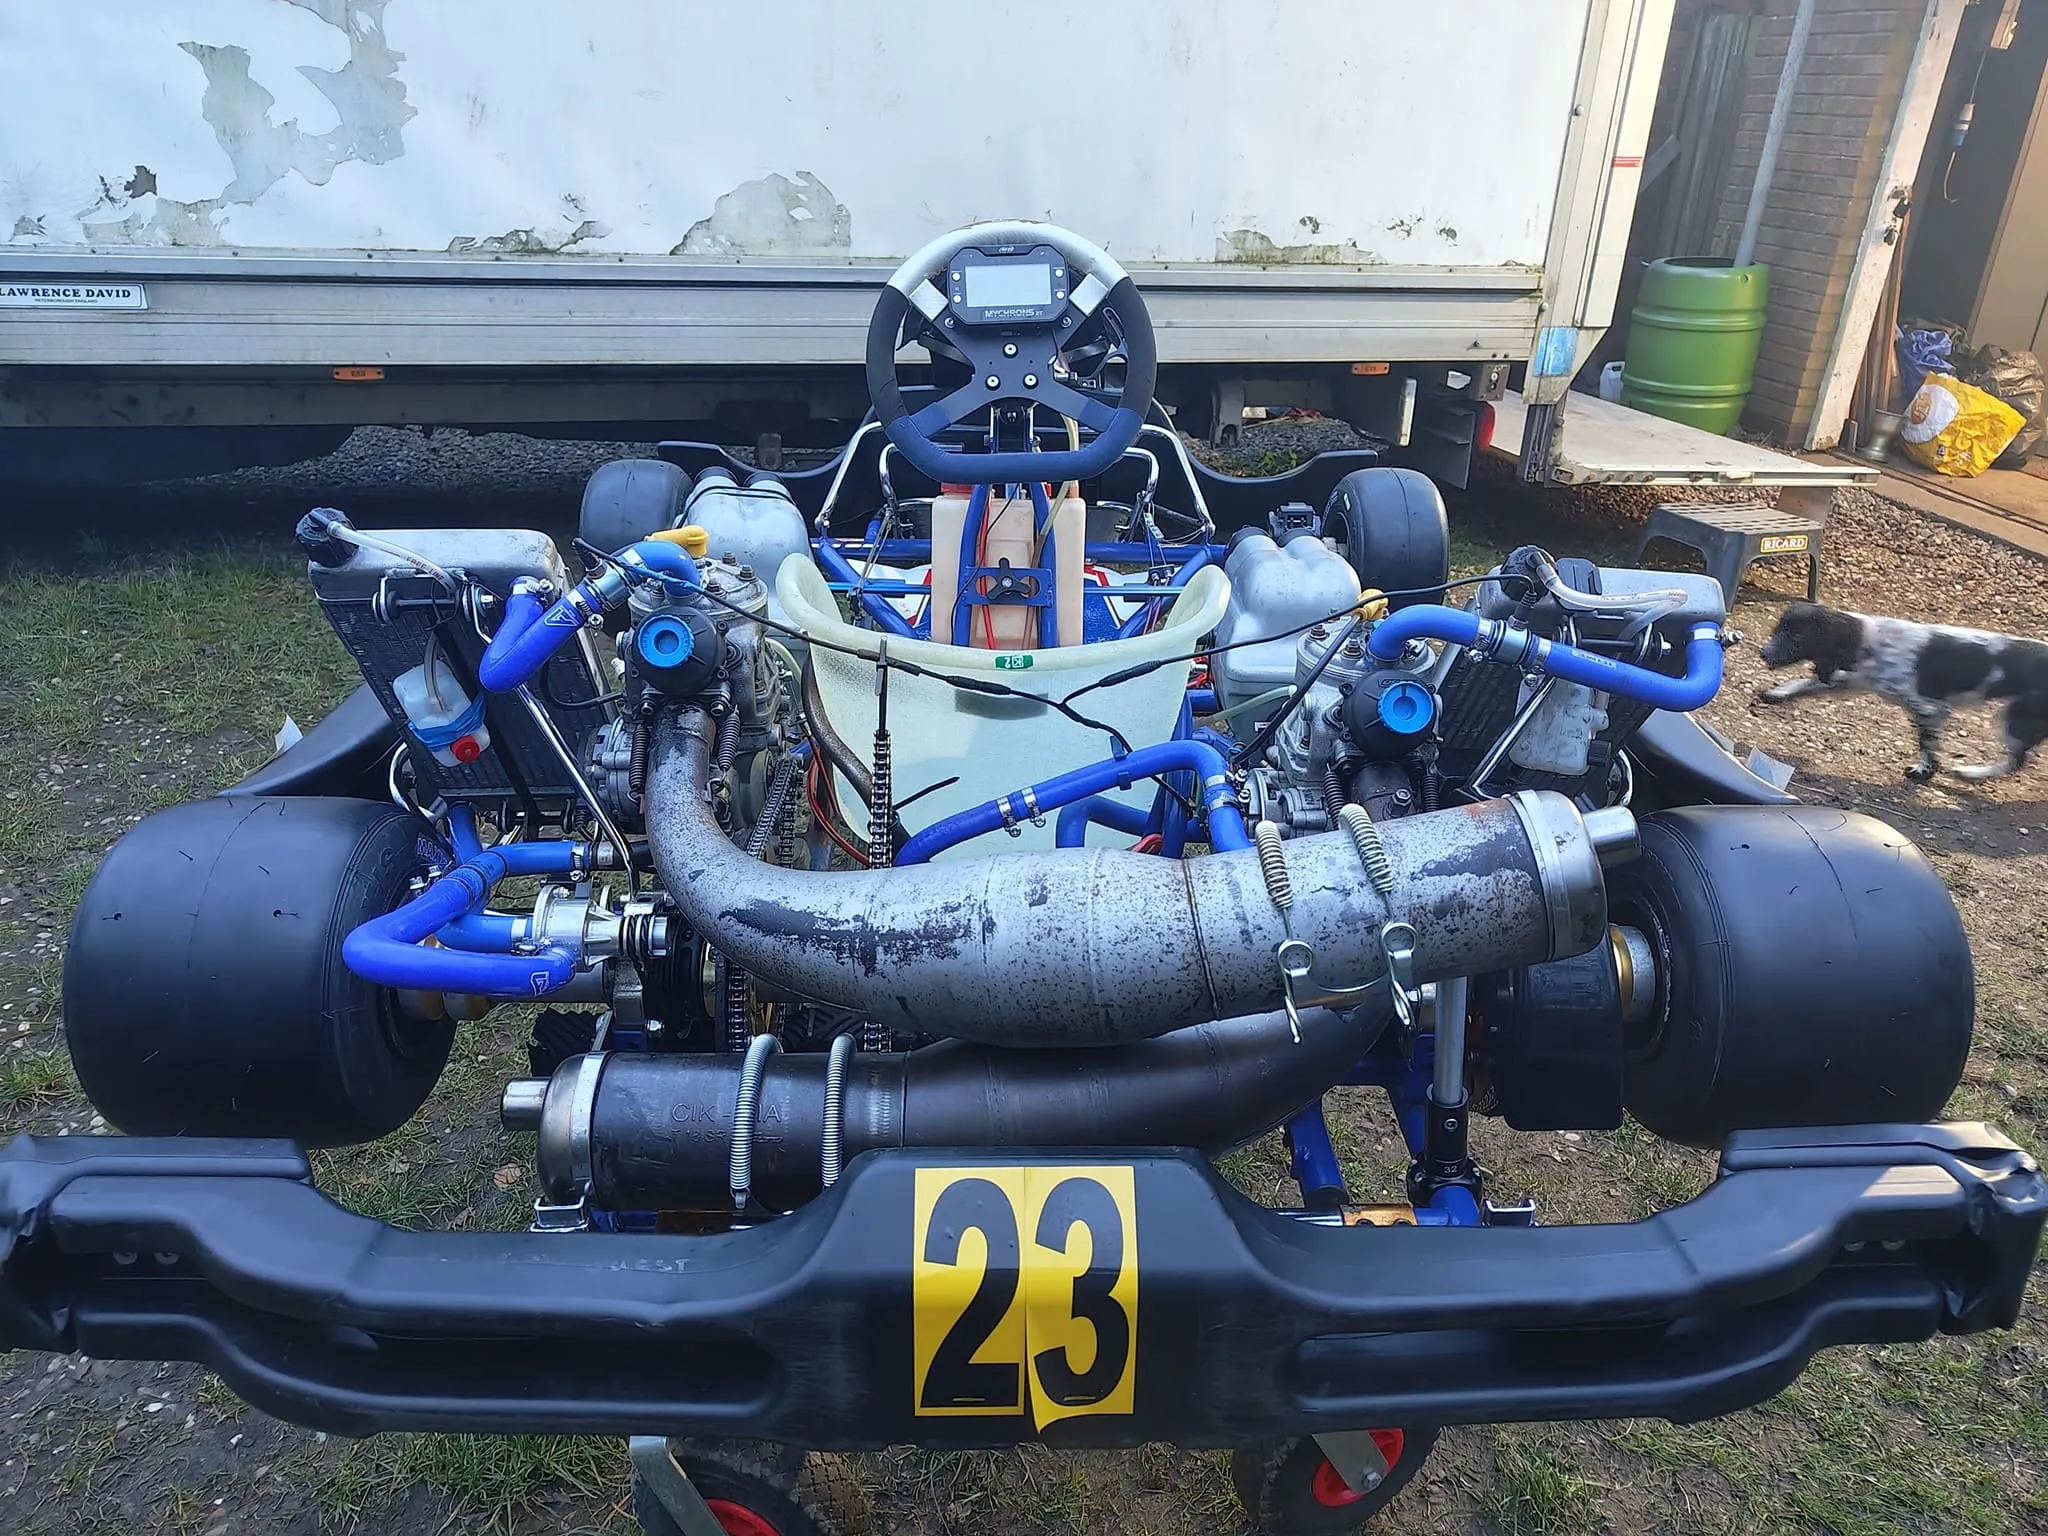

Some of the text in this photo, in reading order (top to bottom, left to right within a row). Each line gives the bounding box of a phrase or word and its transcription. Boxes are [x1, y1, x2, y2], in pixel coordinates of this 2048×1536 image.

[0, 287, 132, 299] LAWRENCE DAVID
[1764, 538, 1805, 550] RICARD
[1443, 1165, 1458, 1174] 32
[920, 1177, 1130, 1408] 23
